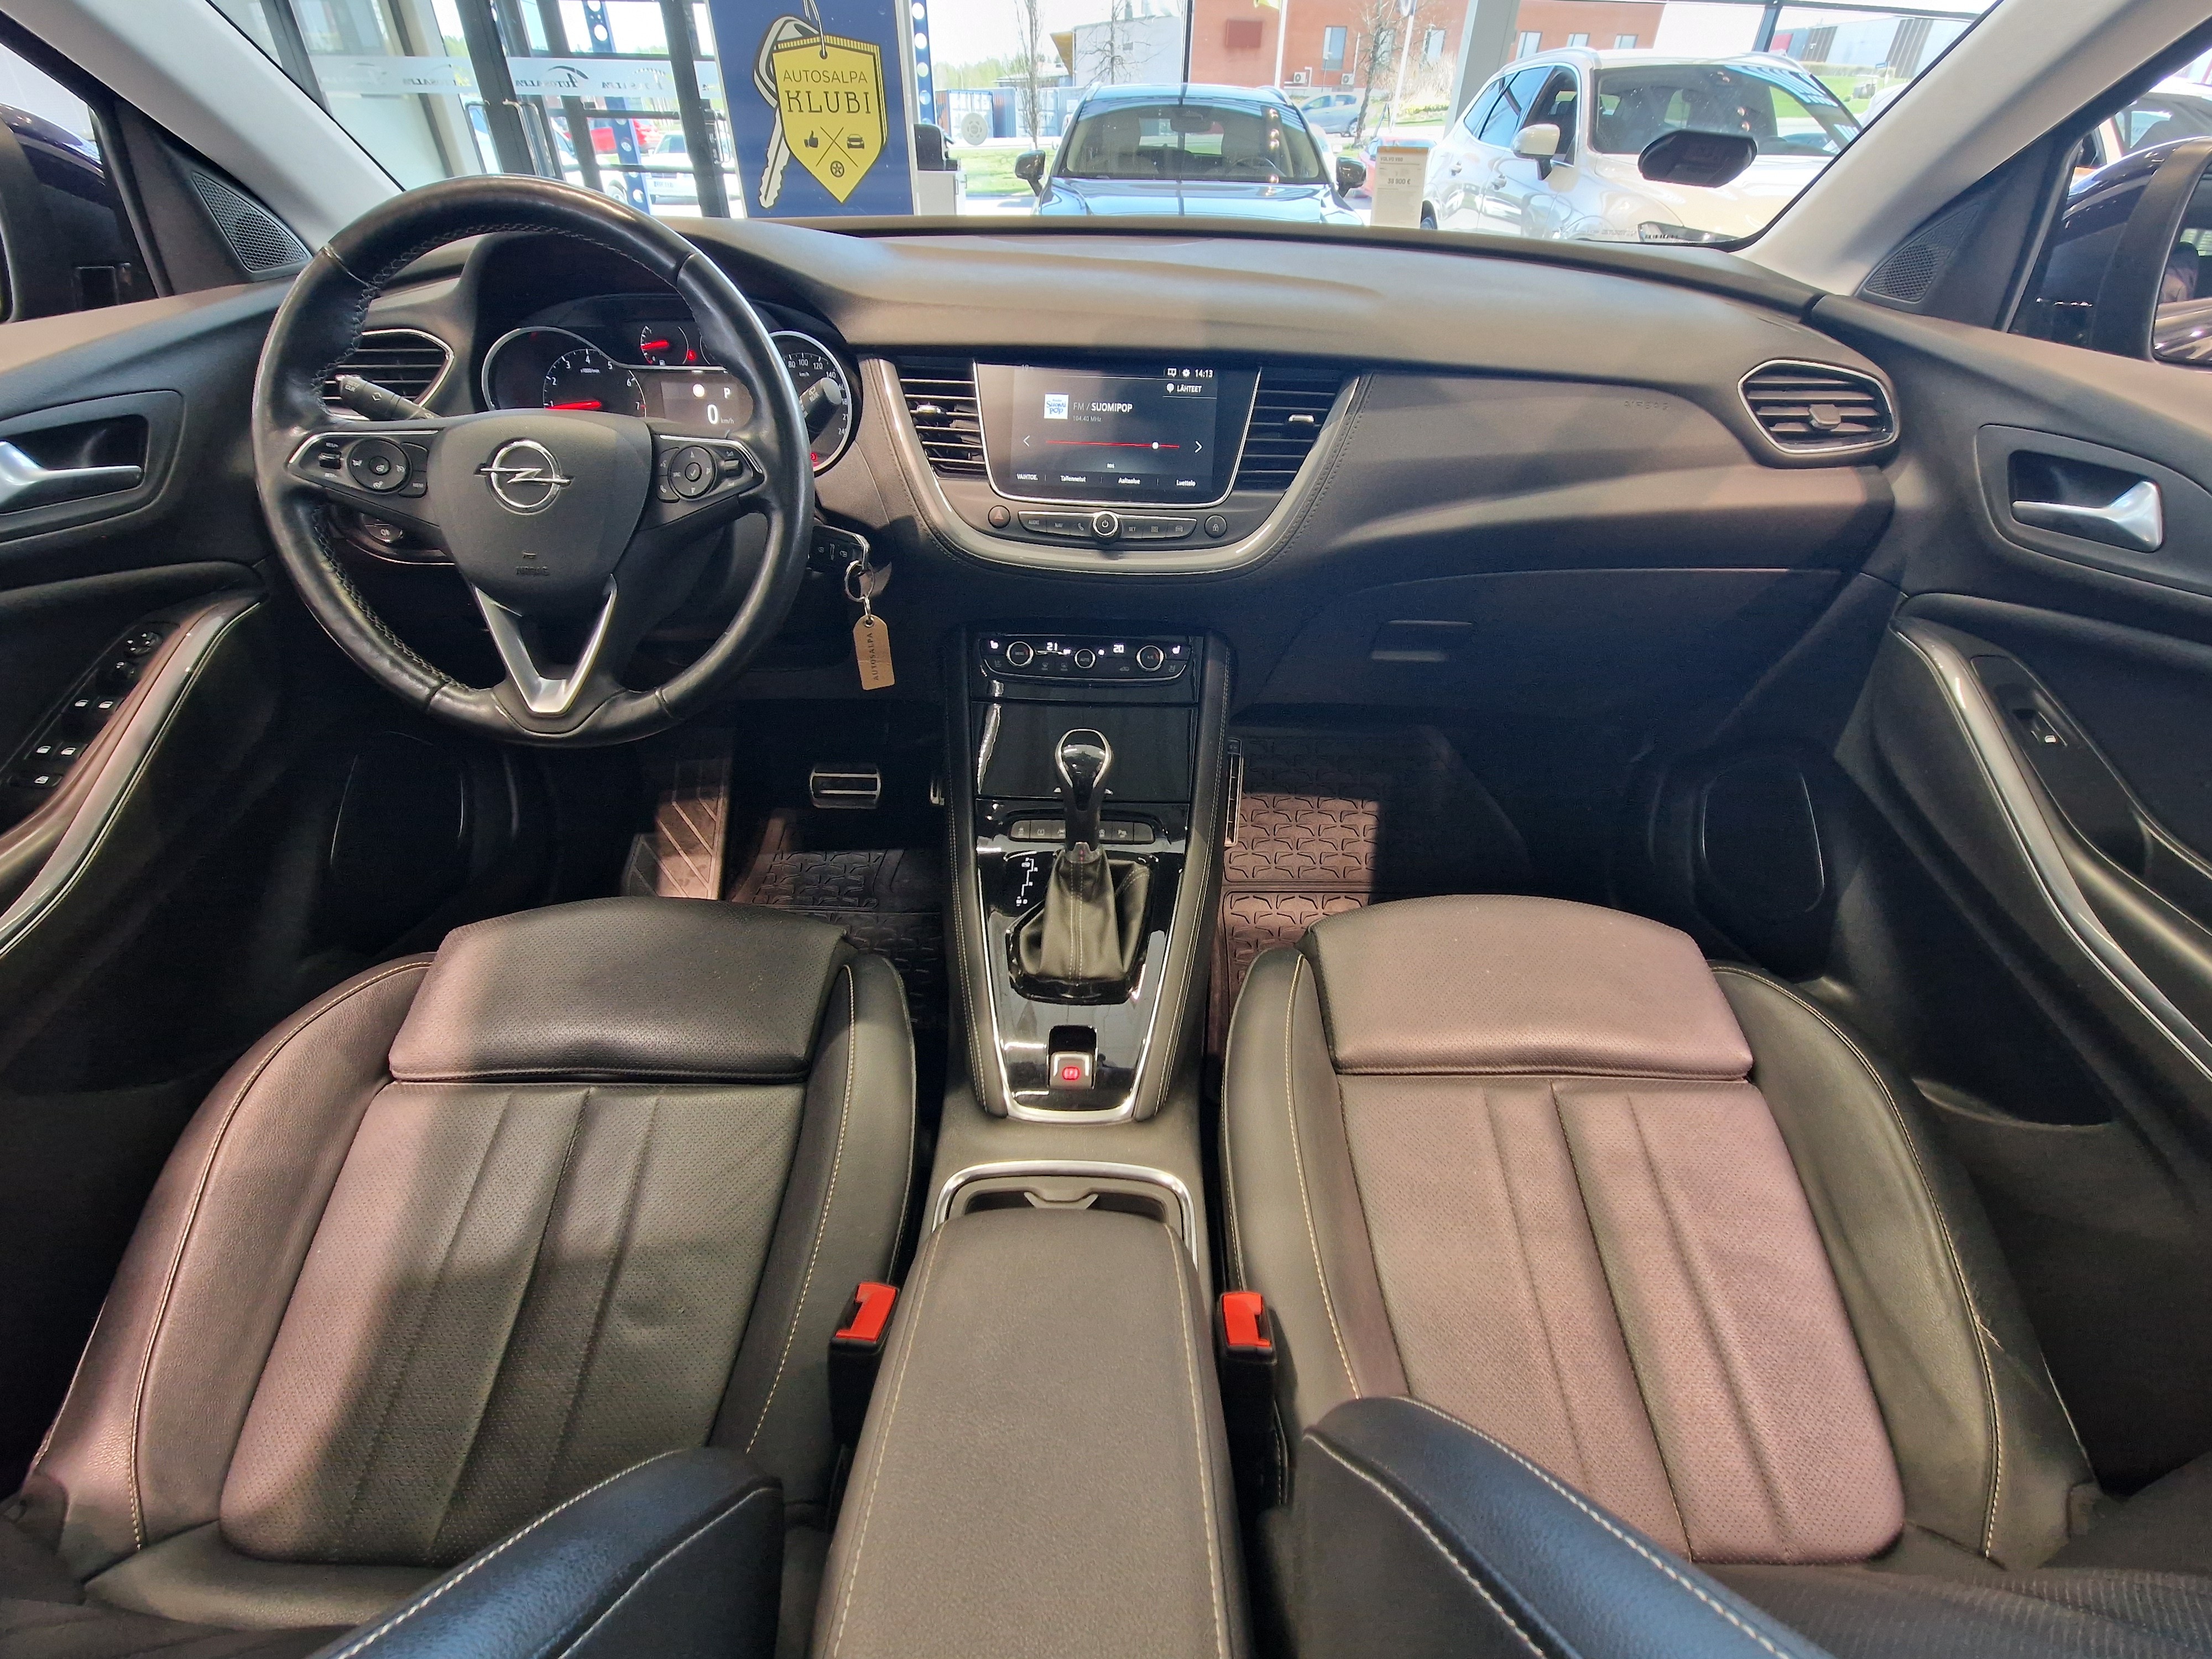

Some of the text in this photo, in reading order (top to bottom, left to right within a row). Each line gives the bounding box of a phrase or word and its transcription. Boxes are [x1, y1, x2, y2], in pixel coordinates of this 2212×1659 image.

[783, 70, 868, 84] AUTOSALPA
[785, 90, 871, 114] KLUBI
[586, 356, 591, 364] 4
[565, 361, 571, 369] 3
[607, 361, 613, 370] 5
[1195, 369, 1213, 378] 14:13
[551, 377, 557, 386] 2
[627, 379, 632, 387] 6
[723, 387, 731, 399] P
[1177, 384, 1202, 393] LÄHTEET
[635, 401, 640, 410] 7
[1073, 402, 1084, 411] FM
[1091, 401, 1133, 413] SUOMIPOP
[707, 404, 718, 425] 0
[1046, 641, 1058, 651] 21
[1113, 644, 1125, 654] 20
[867, 632, 879, 681] AUTOSALPA
